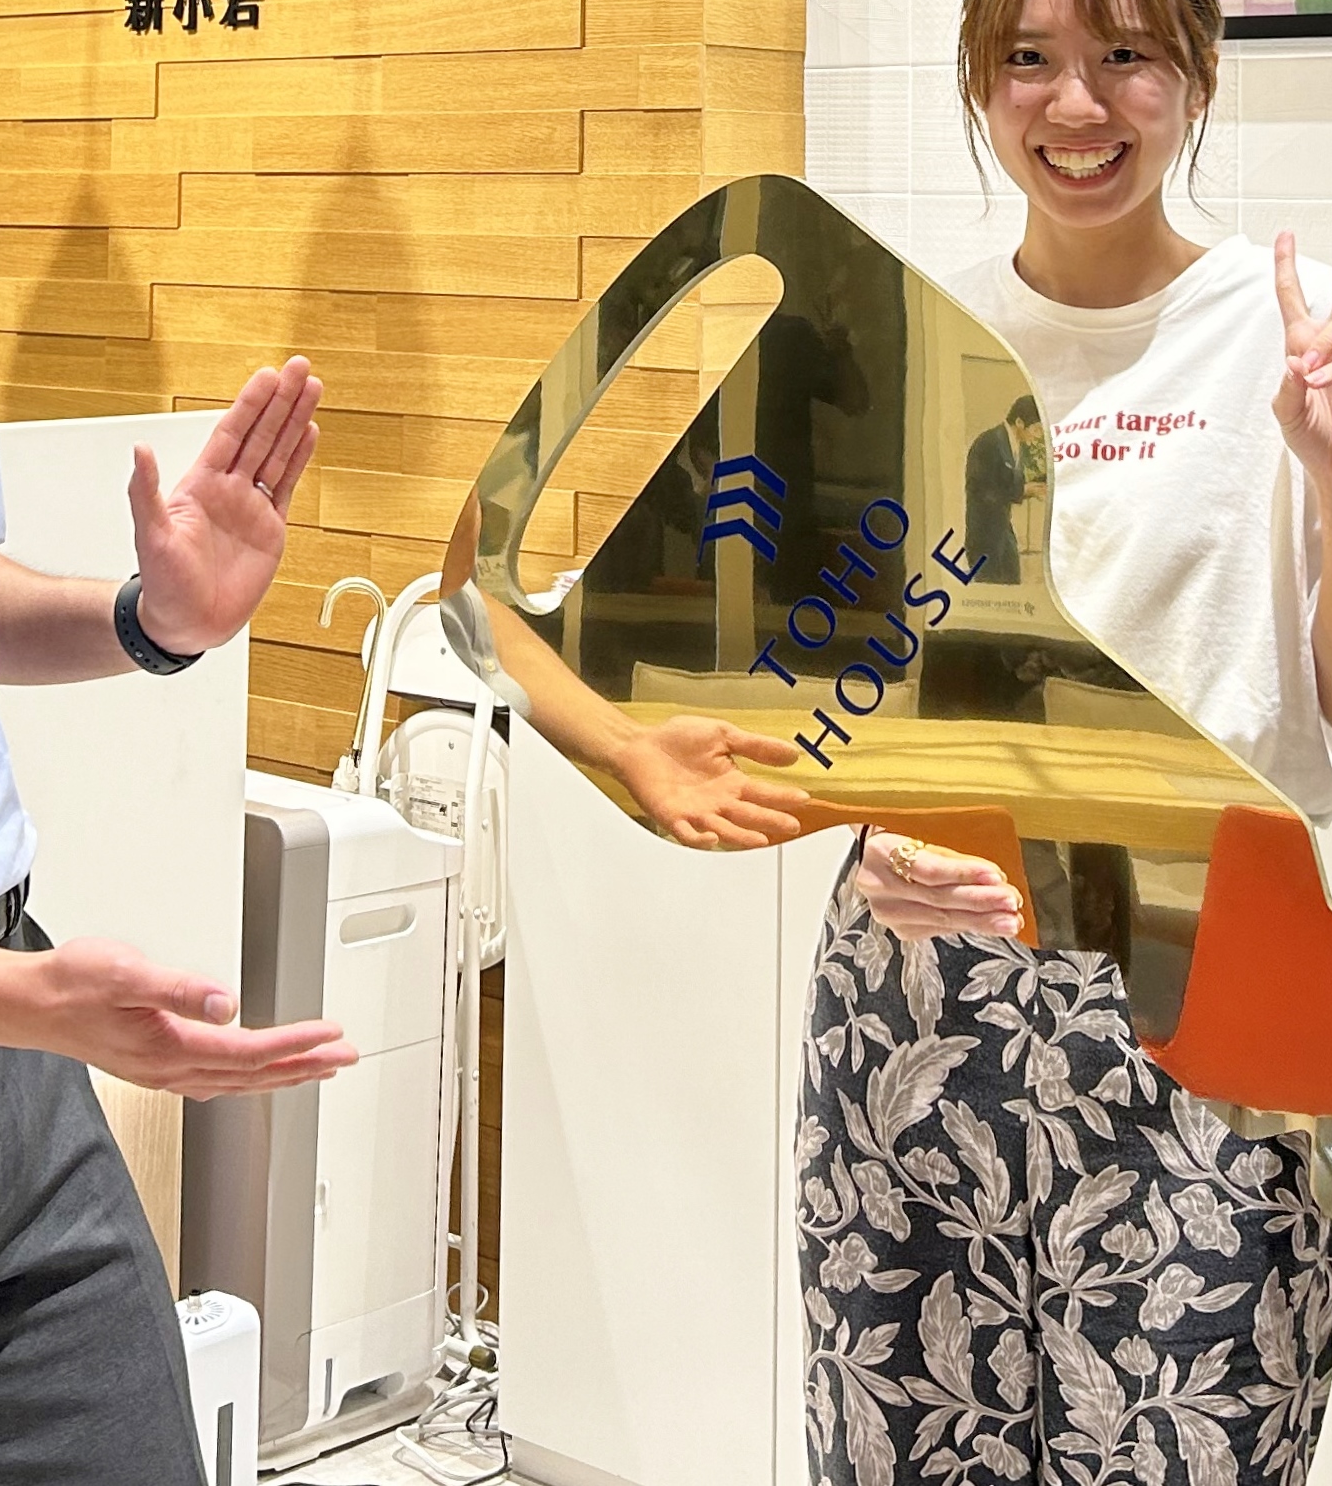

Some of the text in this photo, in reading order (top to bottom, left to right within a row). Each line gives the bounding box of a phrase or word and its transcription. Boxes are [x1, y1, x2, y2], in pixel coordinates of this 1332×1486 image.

[1053, 410, 1207, 438] your target,
[1053, 439, 1156, 462] go for it
[749, 497, 910, 688] TOHO
[794, 527, 988, 770] HOUSE
